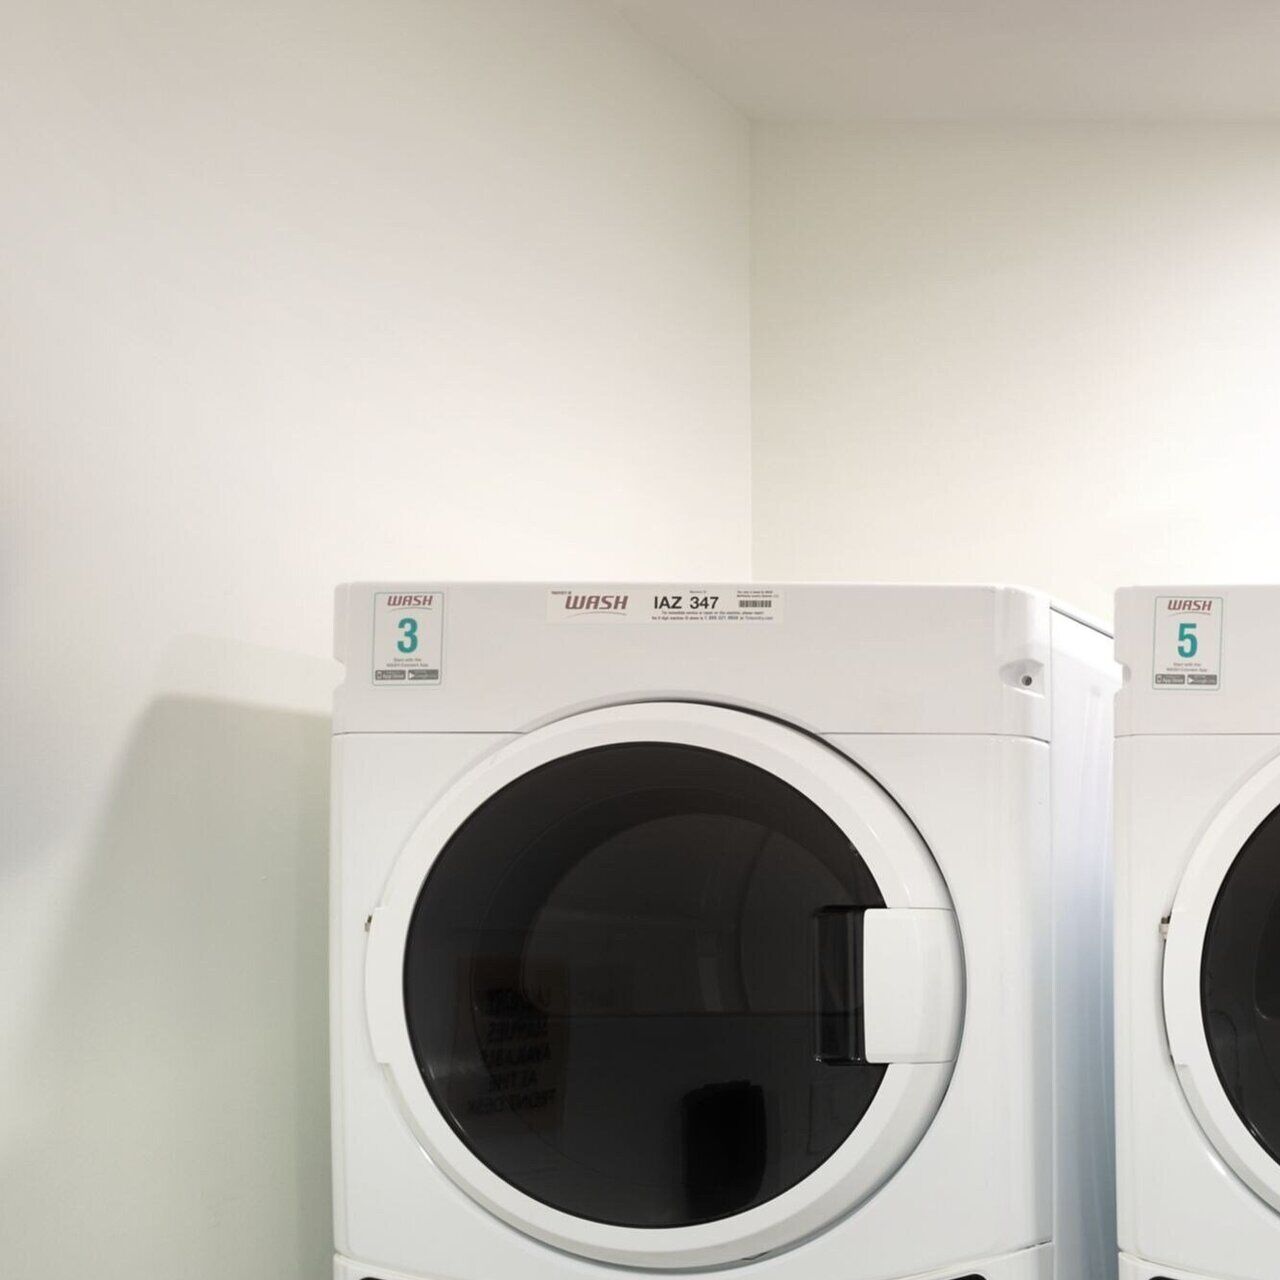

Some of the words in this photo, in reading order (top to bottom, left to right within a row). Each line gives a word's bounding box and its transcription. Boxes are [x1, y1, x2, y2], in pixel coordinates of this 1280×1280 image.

[387, 595, 433, 606] WASH
[565, 595, 629, 610] WASH
[653, 596, 683, 609] IAZ
[690, 596, 720, 609] 347
[1167, 599, 1213, 611] WASH
[397, 617, 418, 654] 3
[1177, 622, 1198, 658] 5
